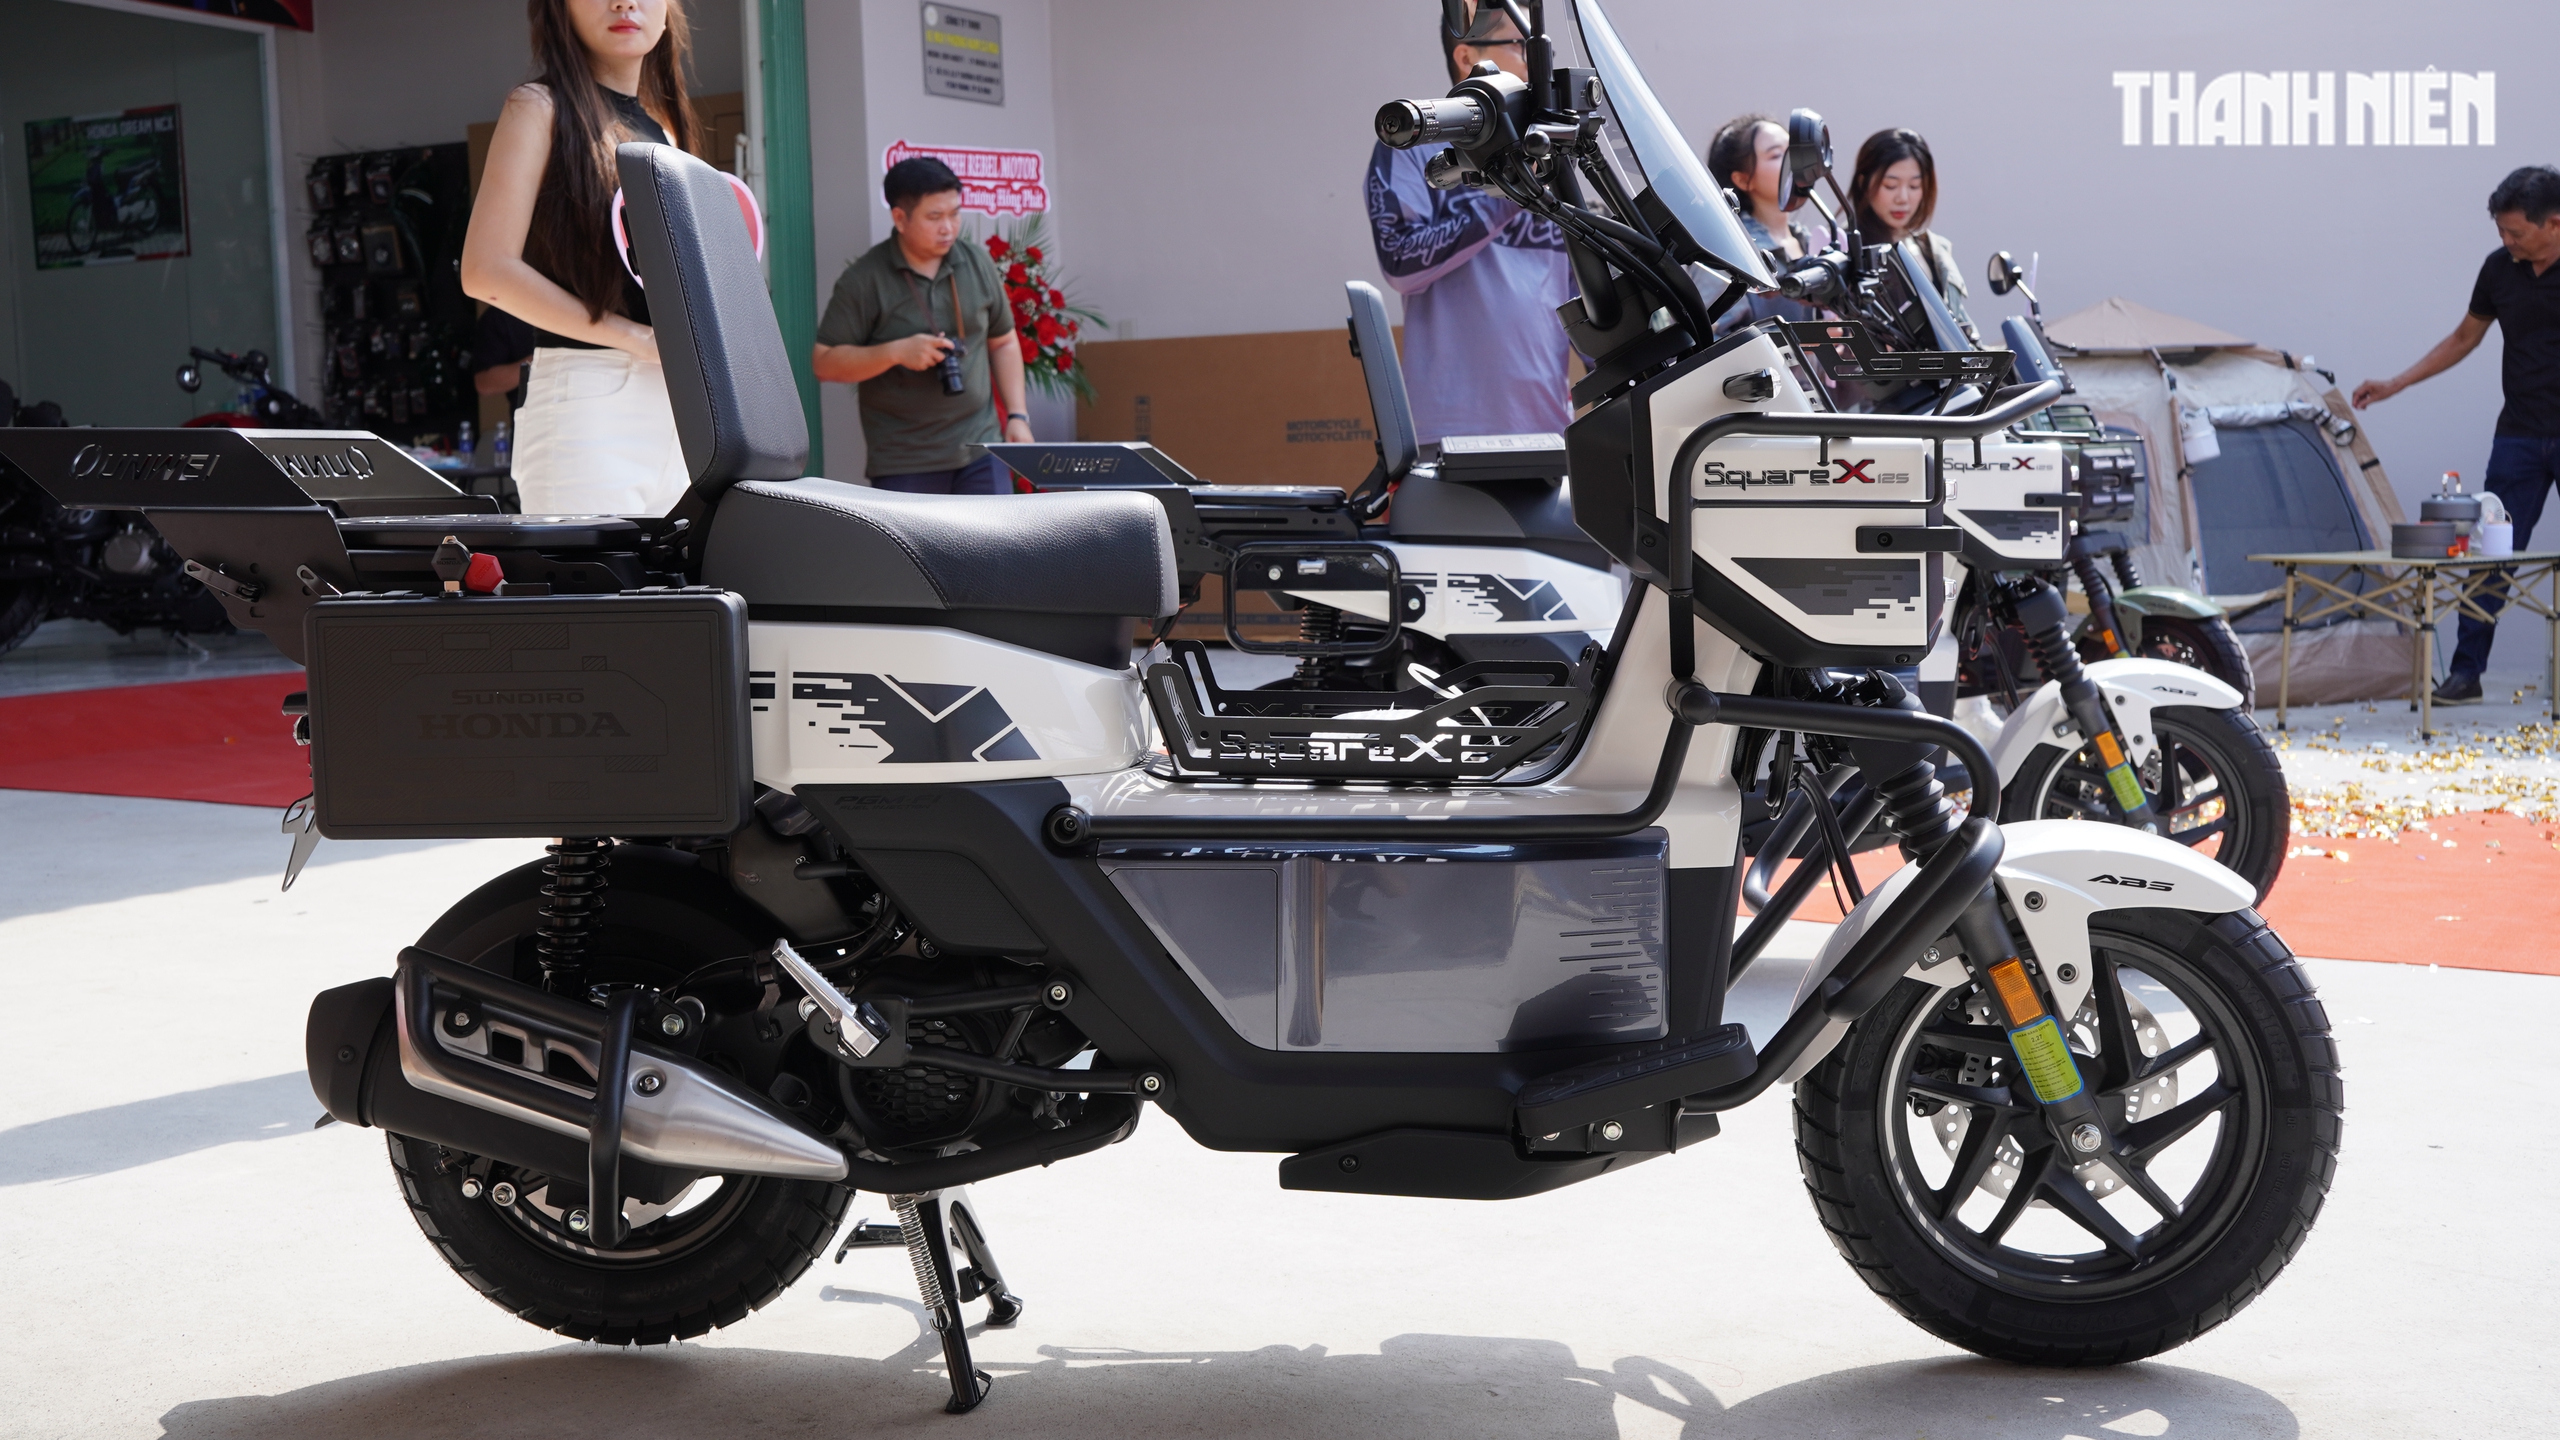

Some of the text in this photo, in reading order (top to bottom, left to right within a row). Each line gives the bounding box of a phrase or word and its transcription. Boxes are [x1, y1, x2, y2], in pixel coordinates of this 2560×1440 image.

[967, 153, 998, 178] REBEL
[999, 155, 1037, 180] MOTOR
[1287, 418, 1361, 431] MOTORCYCLE
[451, 687, 585, 705] SUNDIRO
[2151, 685, 2198, 697] ABS
[417, 711, 632, 740] HONDA
[2087, 874, 2175, 892] ABS
